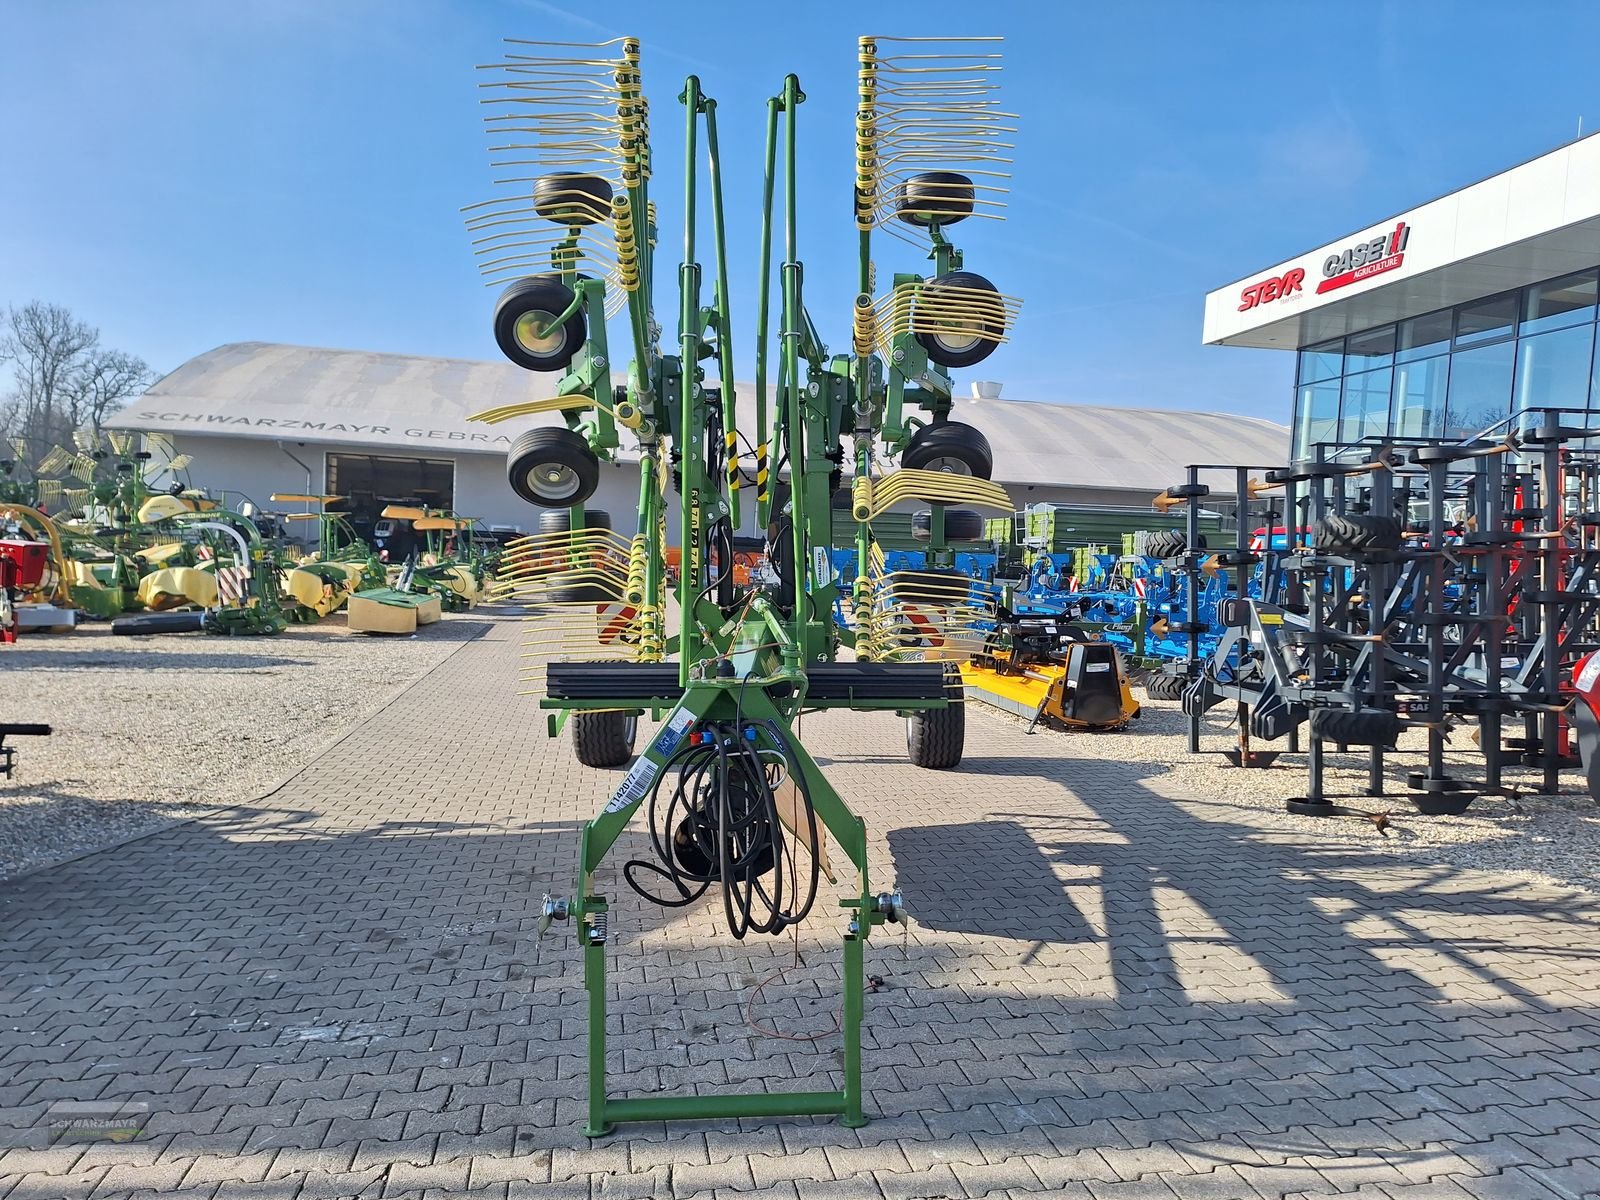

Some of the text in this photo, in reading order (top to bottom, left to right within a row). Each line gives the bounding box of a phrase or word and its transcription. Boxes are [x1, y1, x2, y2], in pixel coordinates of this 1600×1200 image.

[1322, 236, 1387, 278] CASE
[1352, 256, 1399, 279] AGRICULTURE
[1238, 267, 1306, 312] STEYR
[136, 411, 513, 445] SCHWARZMAYR GEBRA
[610, 773, 636, 807] 1142077
